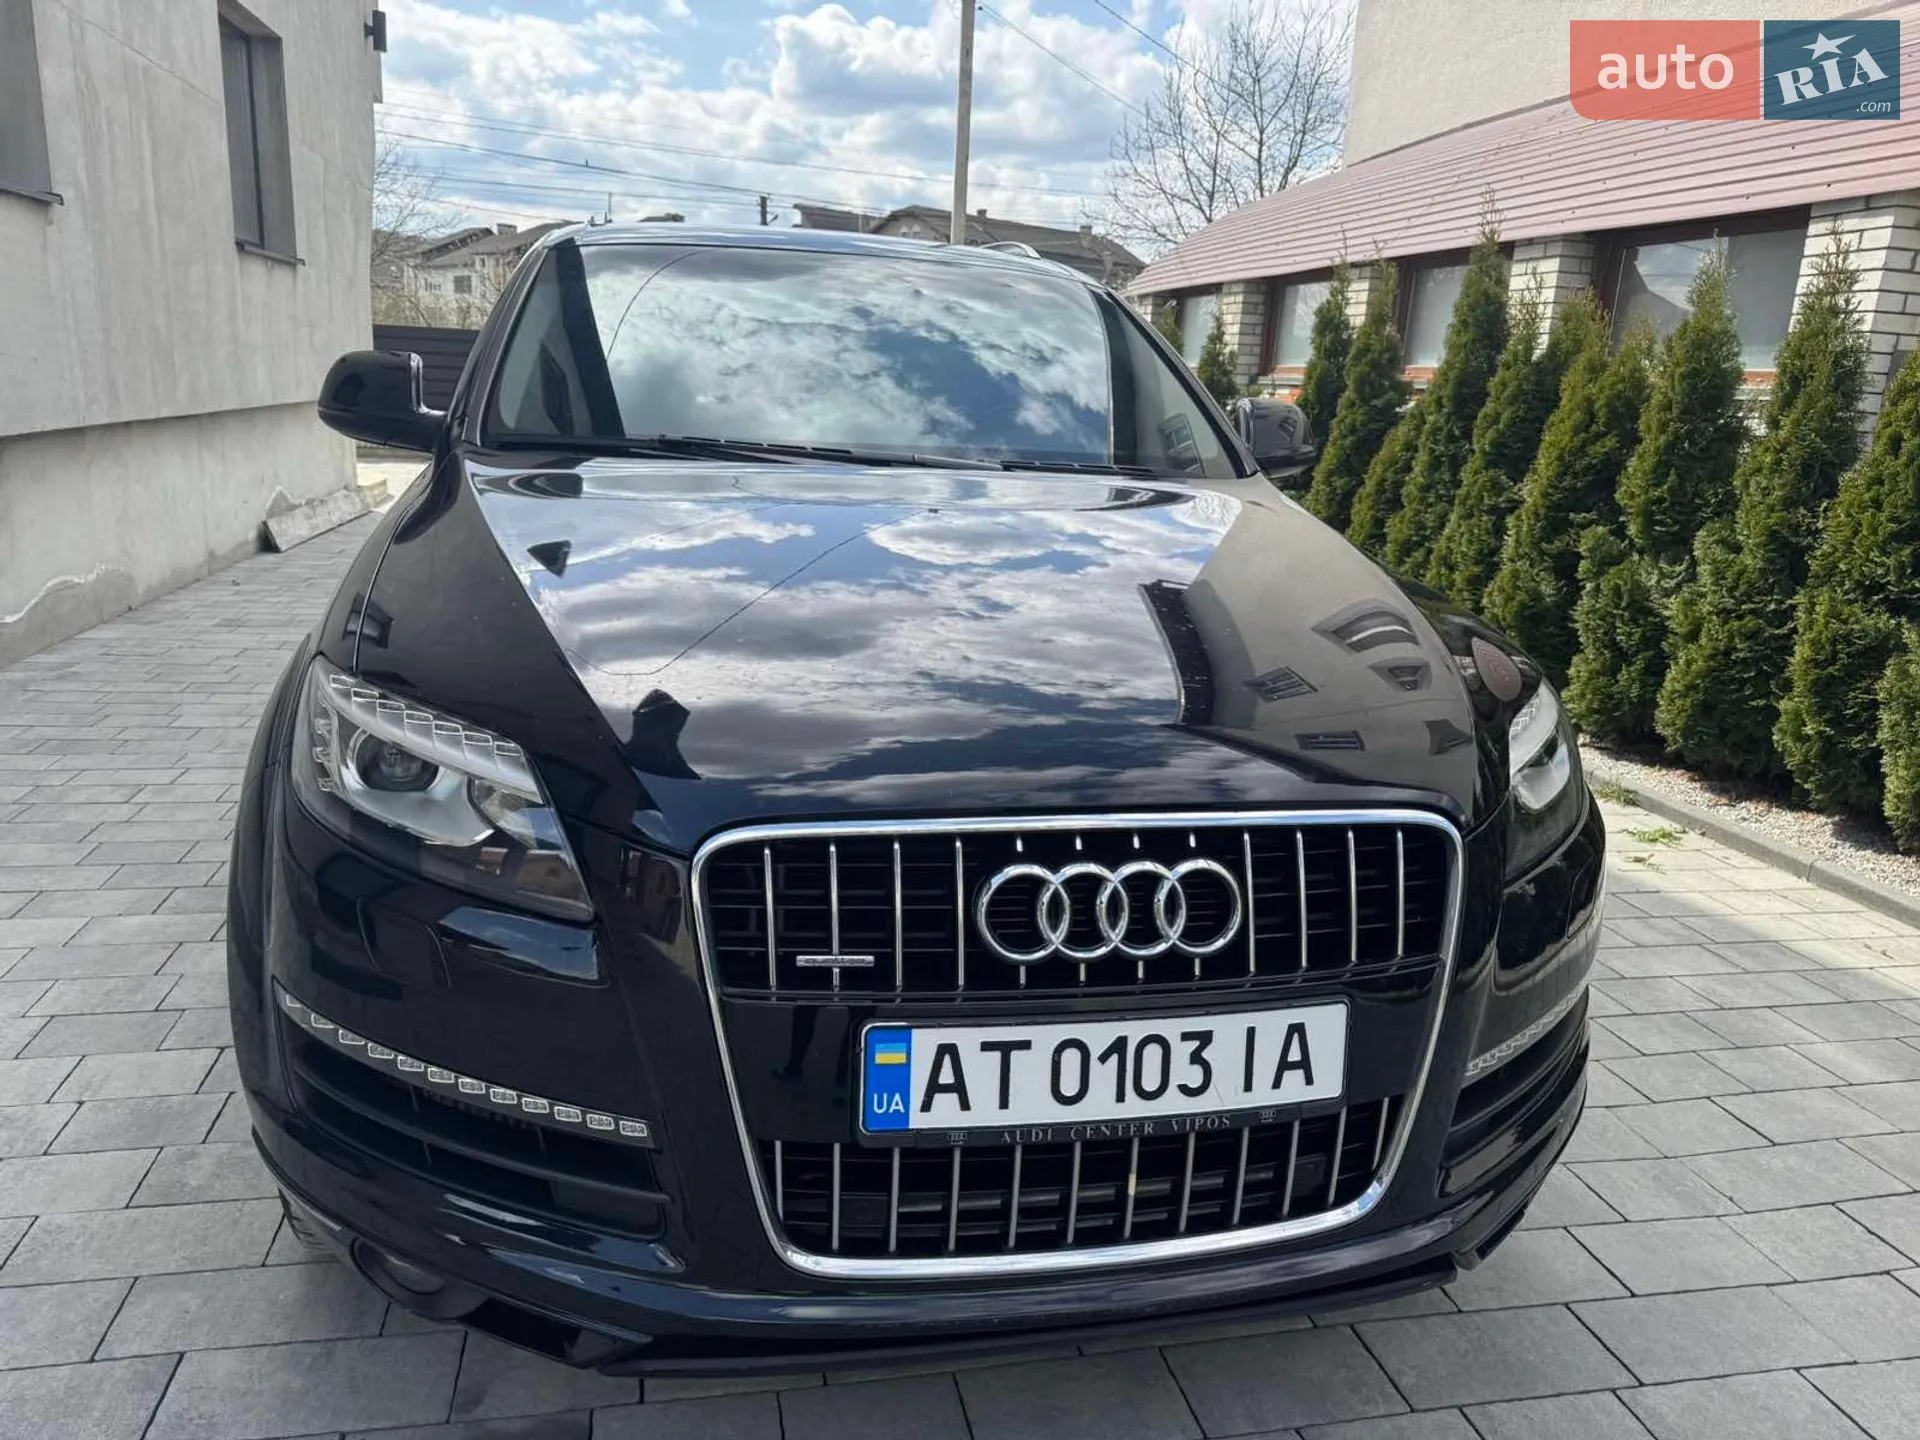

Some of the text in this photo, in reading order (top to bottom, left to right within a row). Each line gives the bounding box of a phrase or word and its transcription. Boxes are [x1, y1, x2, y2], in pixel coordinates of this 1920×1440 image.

[919, 1021, 1314, 1113] AT 0103 IA
[872, 1093, 905, 1114] UA
[1000, 1115, 1232, 1144] AUDI CENTER VIPOS
